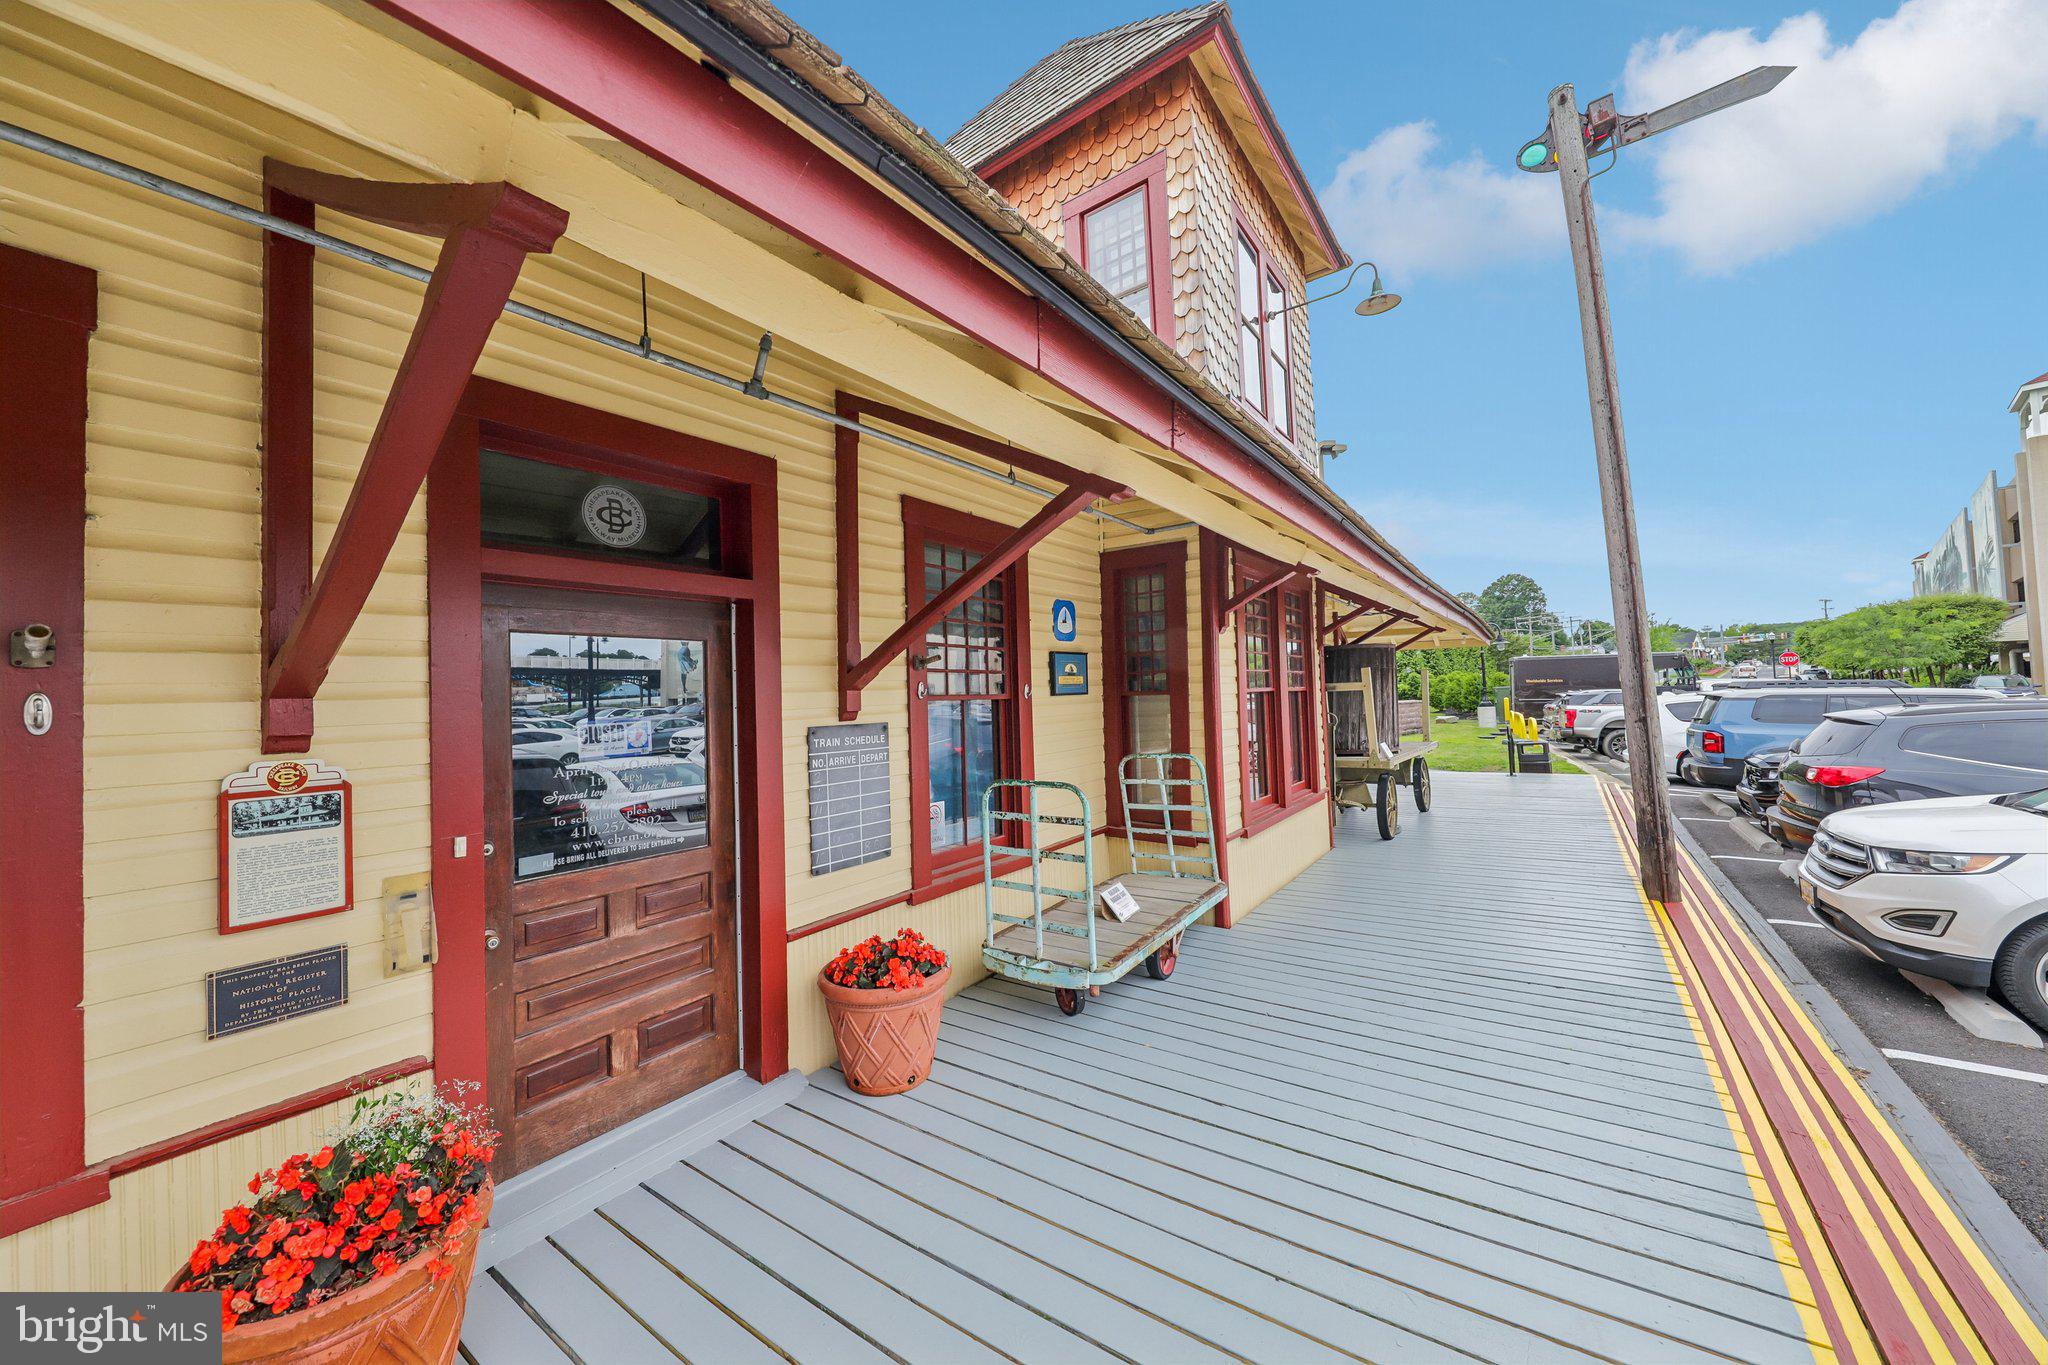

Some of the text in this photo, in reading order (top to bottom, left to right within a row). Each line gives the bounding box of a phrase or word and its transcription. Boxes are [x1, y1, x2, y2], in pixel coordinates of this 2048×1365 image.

[588, 489, 642, 521] CHESAPEAKE BEACH
[588, 516, 642, 542] RAILWAY MUSEUM
[580, 723, 625, 746] CLOSED
[813, 734, 886, 748] TRAIN SCHEDULE
[553, 766, 589, 780] April
[630, 760, 675, 770] October
[812, 752, 888, 769] NO. ARRIVE DEPART
[621, 773, 642, 782] 4PM
[543, 788, 588, 805] Special
[637, 782, 659, 792] other
[661, 779, 683, 789] hours
[551, 816, 566, 828] To
[627, 804, 657, 818] please
[660, 799, 677, 811] call
[570, 815, 662, 839] 410.257.3892
[542, 838, 677, 868] PLEASE BRING ALL DELIVERIES TO SIDE ENTRANCE
[240, 969, 274, 981] PROPERTY
[276, 965, 291, 973] HAS
[292, 961, 310, 969] BEEN
[312, 955, 337, 964] PLACED
[232, 970, 328, 997] NATIONAL REGISTER
[276, 985, 288, 993] OF
[239, 985, 322, 1010] HISTORIC PLACES
[270, 1001, 296, 1011] UNITED
[298, 995, 322, 1004] STATES
[224, 1011, 273, 1028] DEPARTMENT
[304, 995, 336, 1007] INTERIOR
